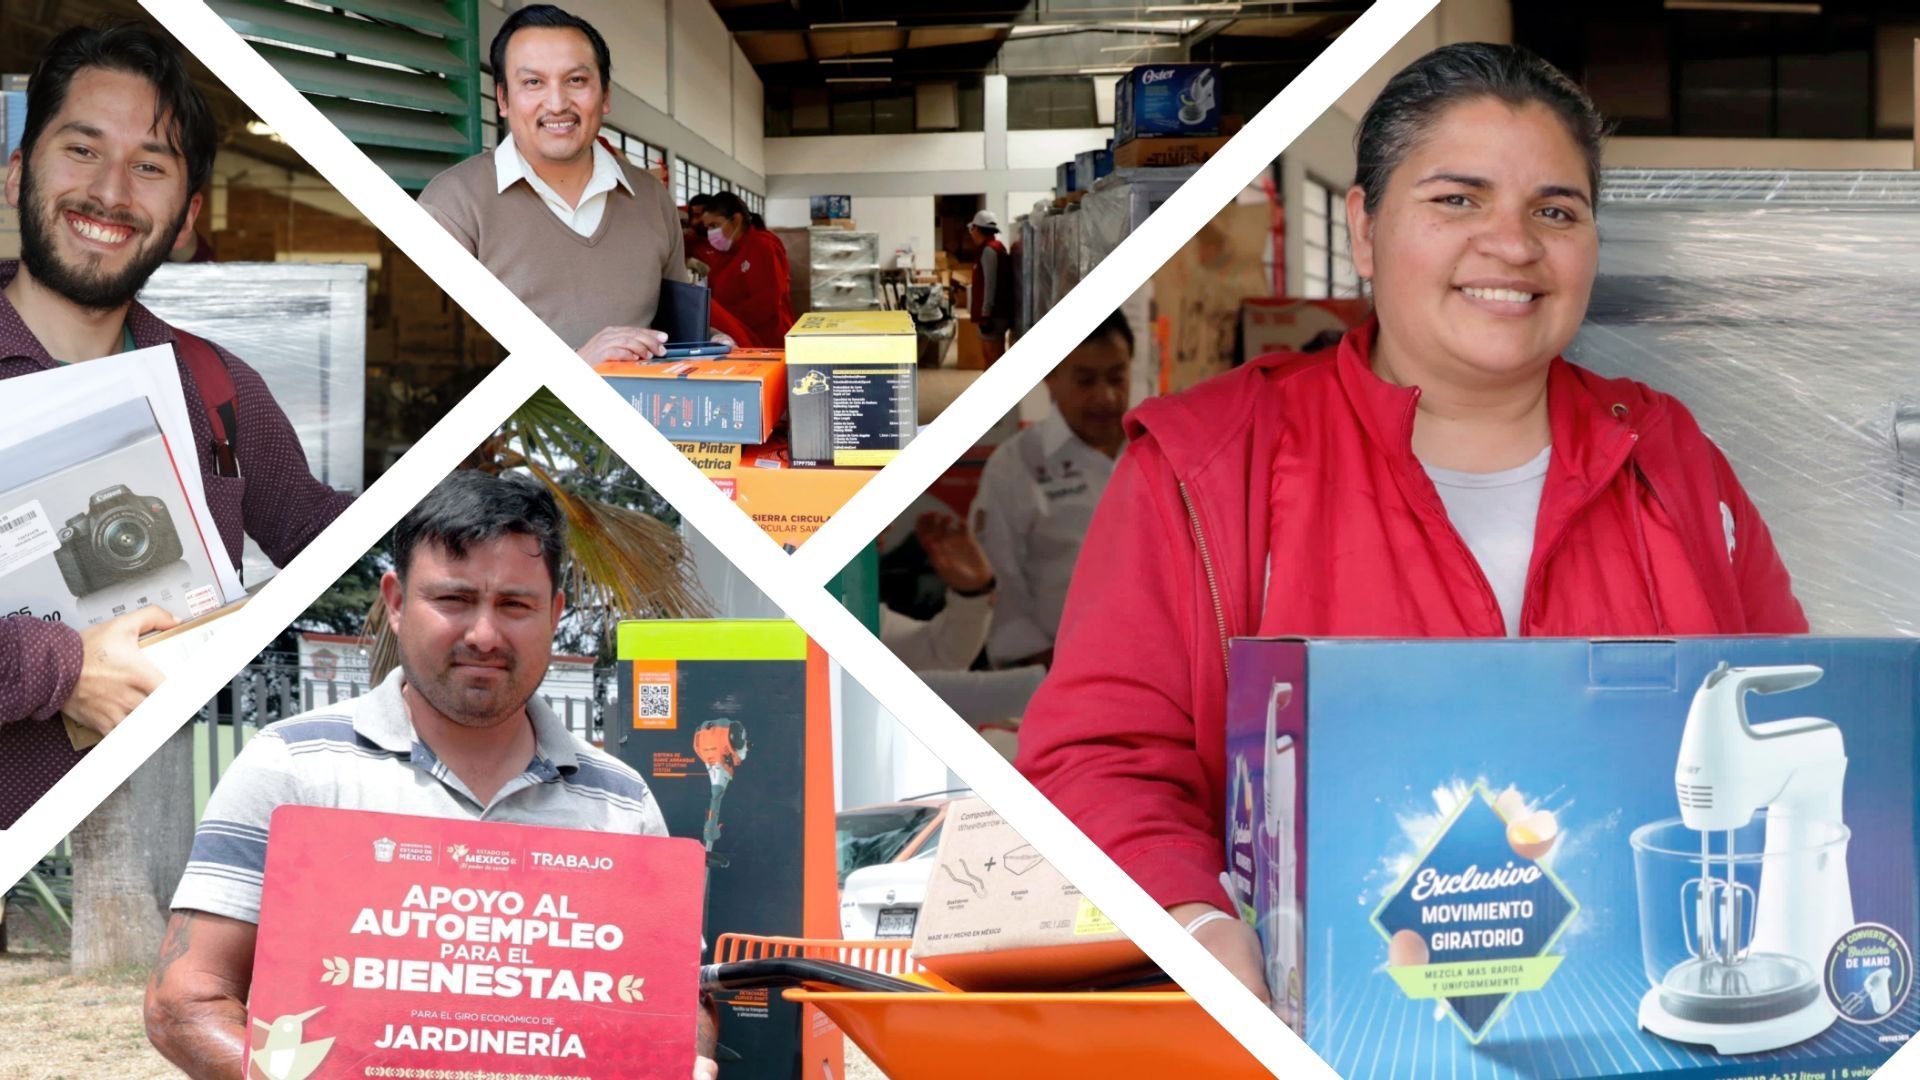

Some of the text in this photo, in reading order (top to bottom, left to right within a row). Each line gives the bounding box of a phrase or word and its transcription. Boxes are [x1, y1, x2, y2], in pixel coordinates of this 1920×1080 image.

[1142, 69, 1175, 84] Oster
[673, 442, 736, 454] ara Pintar
[688, 457, 732, 469] éctrica
[752, 514, 787, 522] SIERRA
[760, 524, 820, 533] RCULAR SAW
[531, 852, 614, 870] TRABAJO
[1411, 861, 1543, 900] Exclusivo
[402, 884, 578, 920] APOYO AL
[1422, 900, 1533, 924] MOVIMIENTO
[350, 908, 624, 951] AUTOEMPLEO
[981, 928, 1001, 936] MÉXICO
[1431, 928, 1524, 951] GIRATORIO
[1836, 929, 1898, 953] SE CONVIERTE EN
[440, 943, 533, 964] PARA EL
[1846, 956, 1890, 968] DE MANO
[353, 957, 613, 1003] BIENESTAR
[1424, 969, 1463, 979] MEZCLA
[1432, 977, 1520, 991] Y UNIFORMEMENTE
[411, 1010, 555, 1025] PARA EL GIRO ECONÓMICO DE
[374, 1022, 586, 1060] JARDINERÍA
[1842, 1068, 1848, 1078] 6
